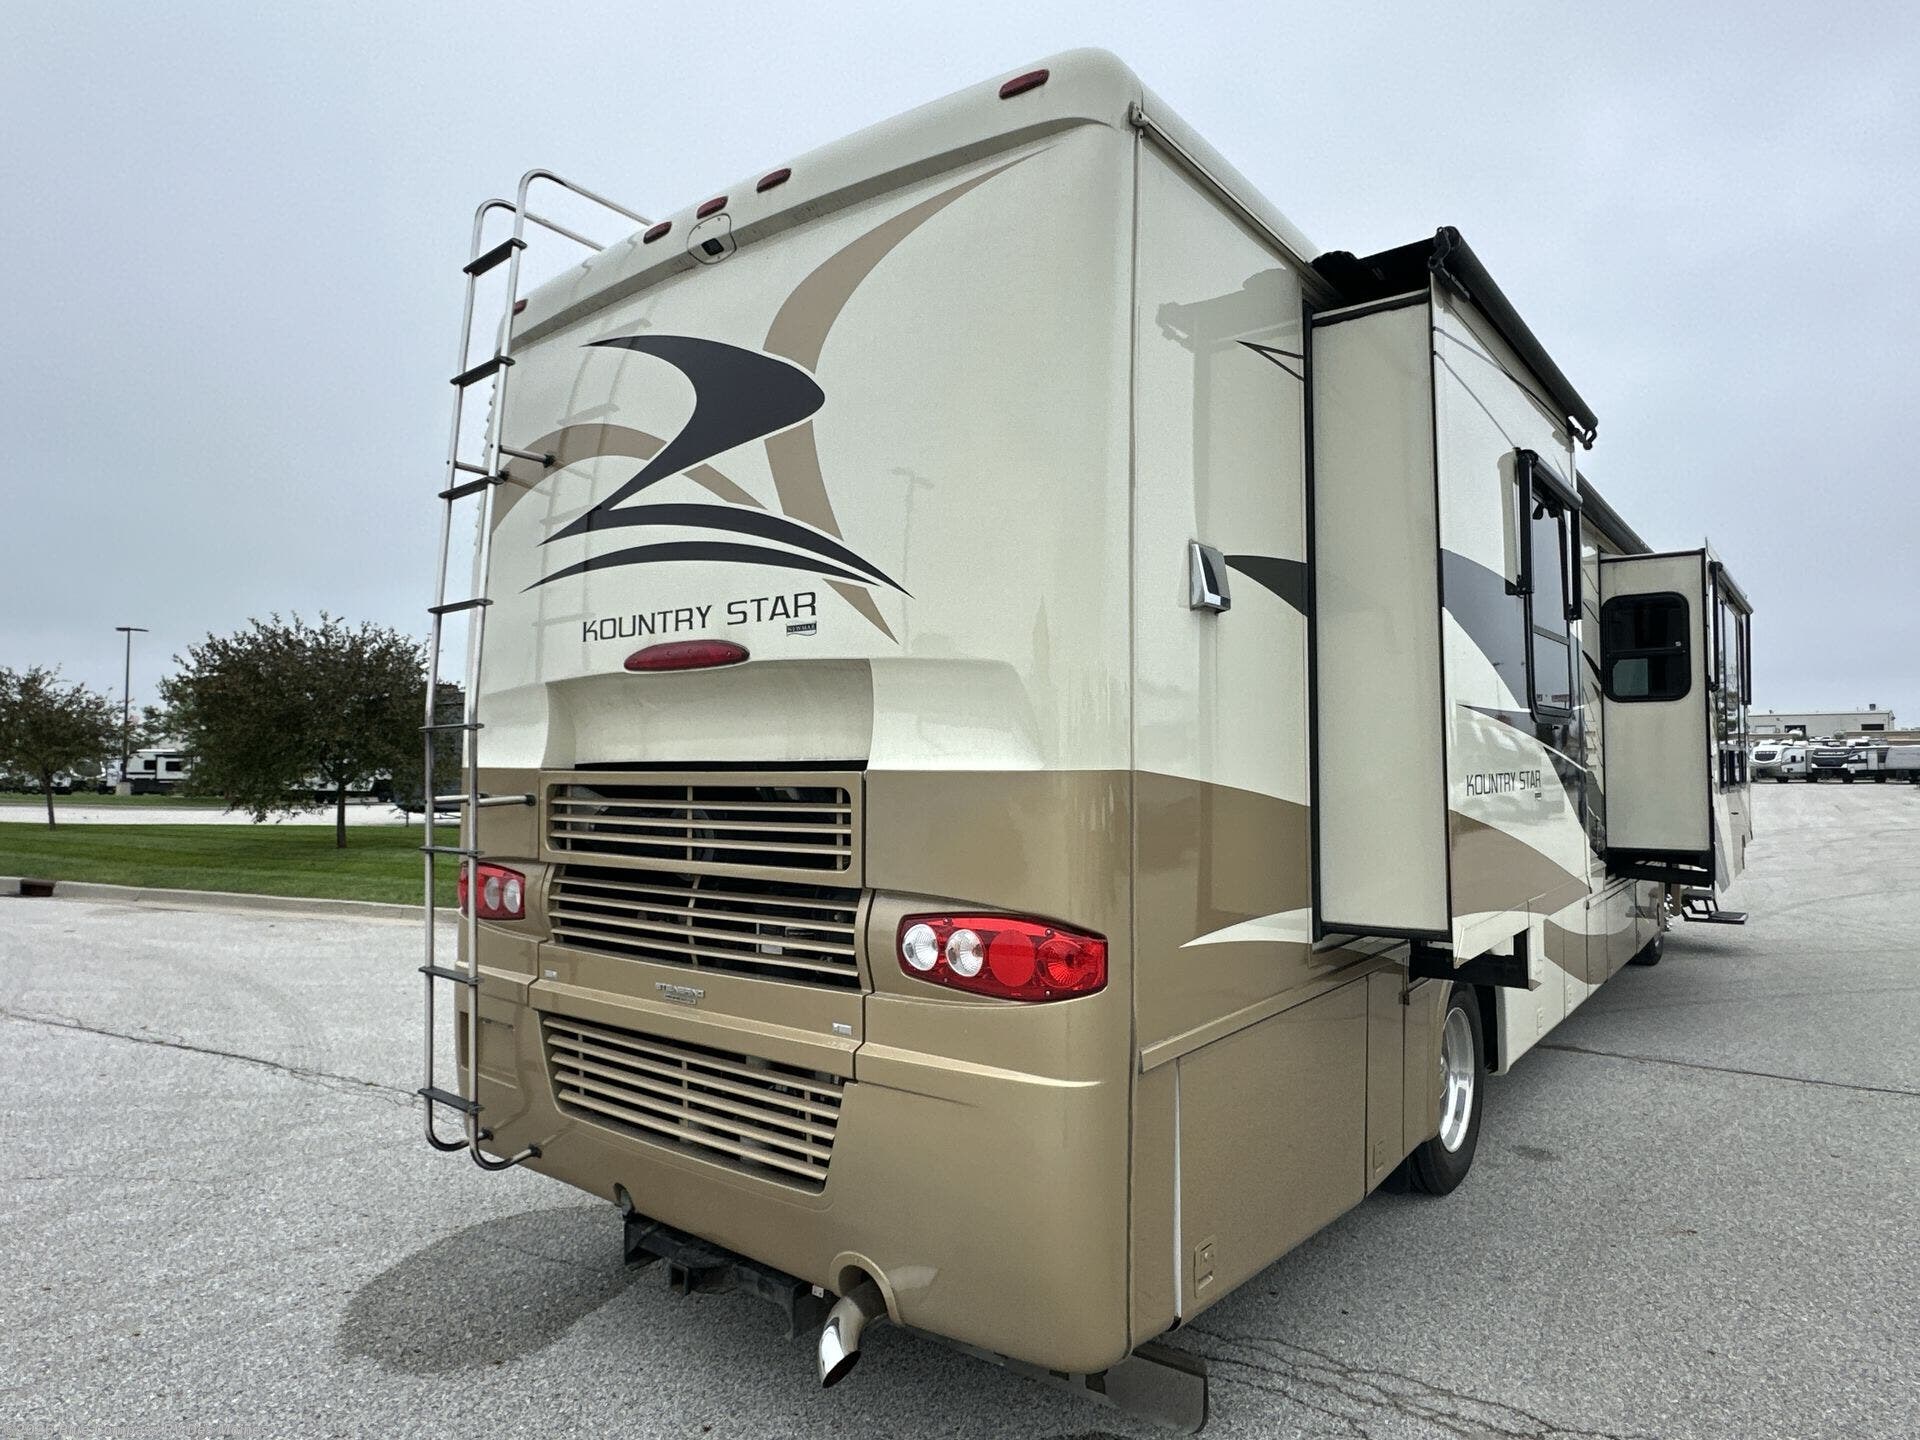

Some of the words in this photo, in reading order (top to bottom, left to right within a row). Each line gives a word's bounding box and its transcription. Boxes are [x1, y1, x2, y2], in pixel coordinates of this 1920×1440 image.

[582, 604, 712, 642] KOUNTRY
[727, 591, 817, 626] STAR
[1466, 772, 1516, 797] KOUNTRY
[1519, 770, 1541, 790] STAR
